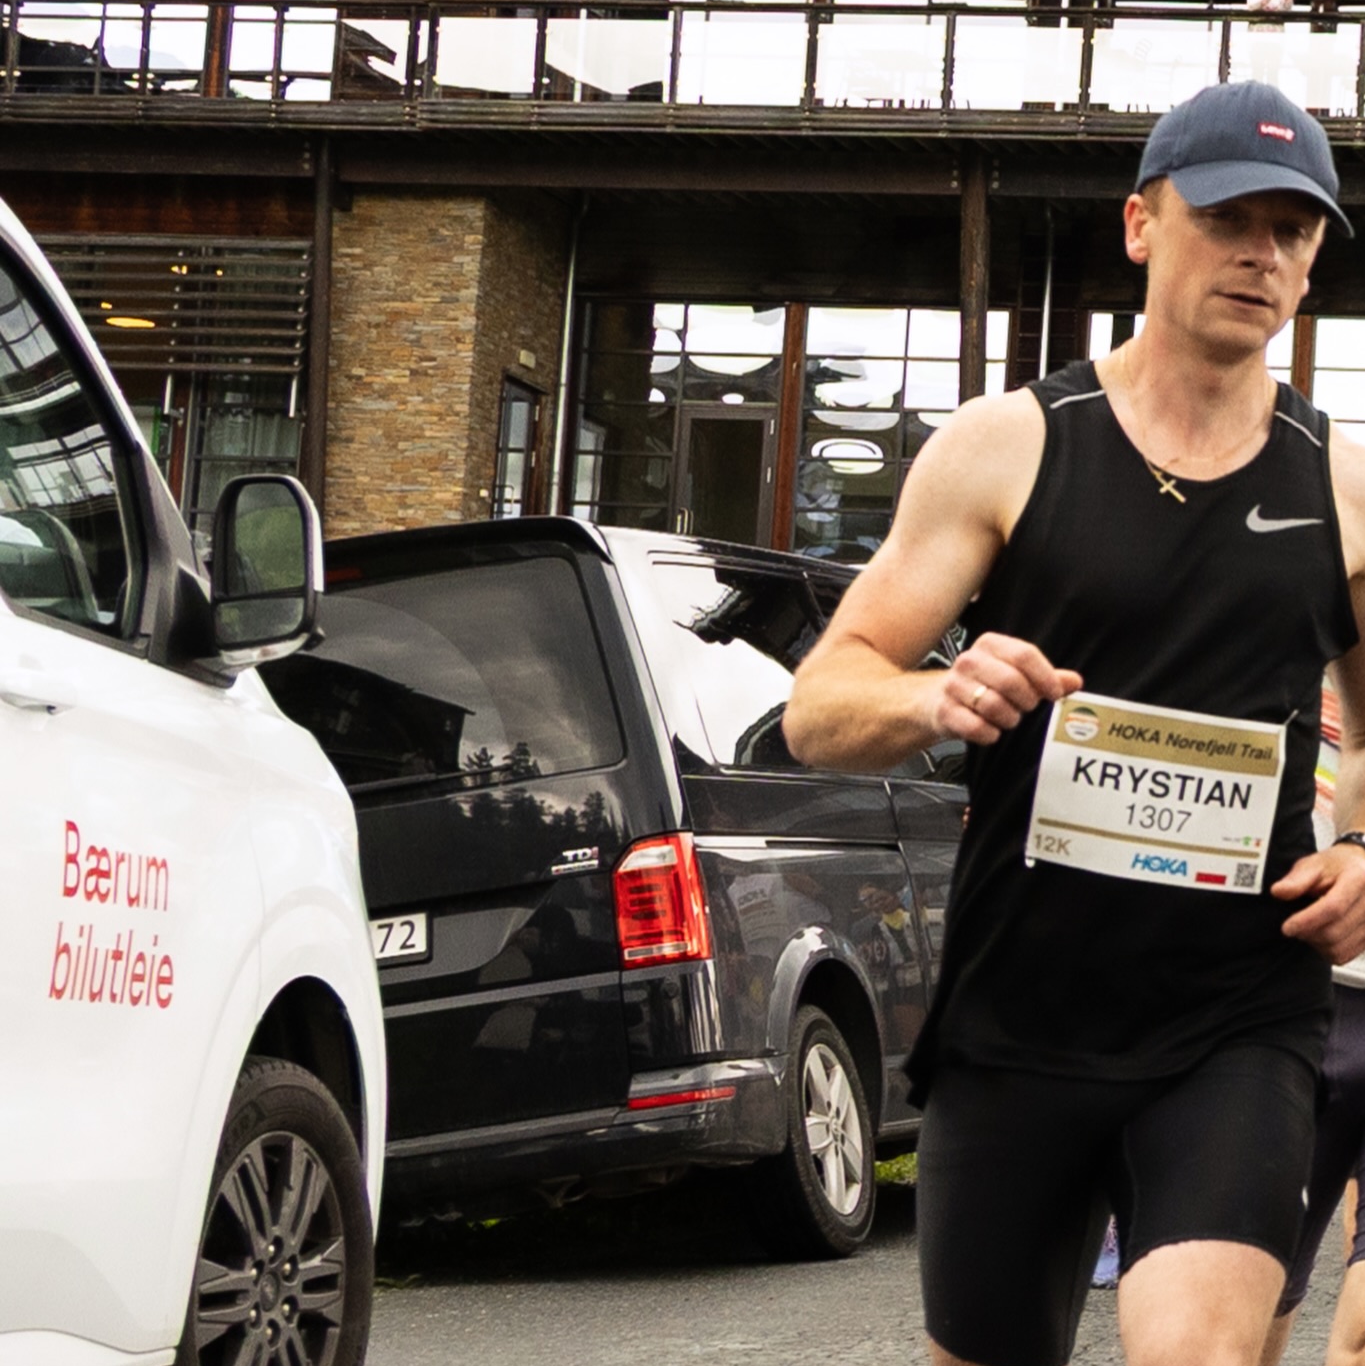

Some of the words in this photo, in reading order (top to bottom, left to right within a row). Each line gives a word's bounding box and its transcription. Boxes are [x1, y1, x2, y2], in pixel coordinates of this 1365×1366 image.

[1108, 723, 1160, 744] HOKA
[1165, 734, 1236, 757] Norefjell
[1241, 743, 1273, 761] Trail
[1072, 756, 1252, 809] KRYSTIAN
[1126, 803, 1192, 833] 1307
[1032, 834, 1071, 856] 12K
[63, 820, 168, 911] Bærum
[1131, 853, 1188, 876] HOKA
[49, 922, 173, 1009] bilutleie
